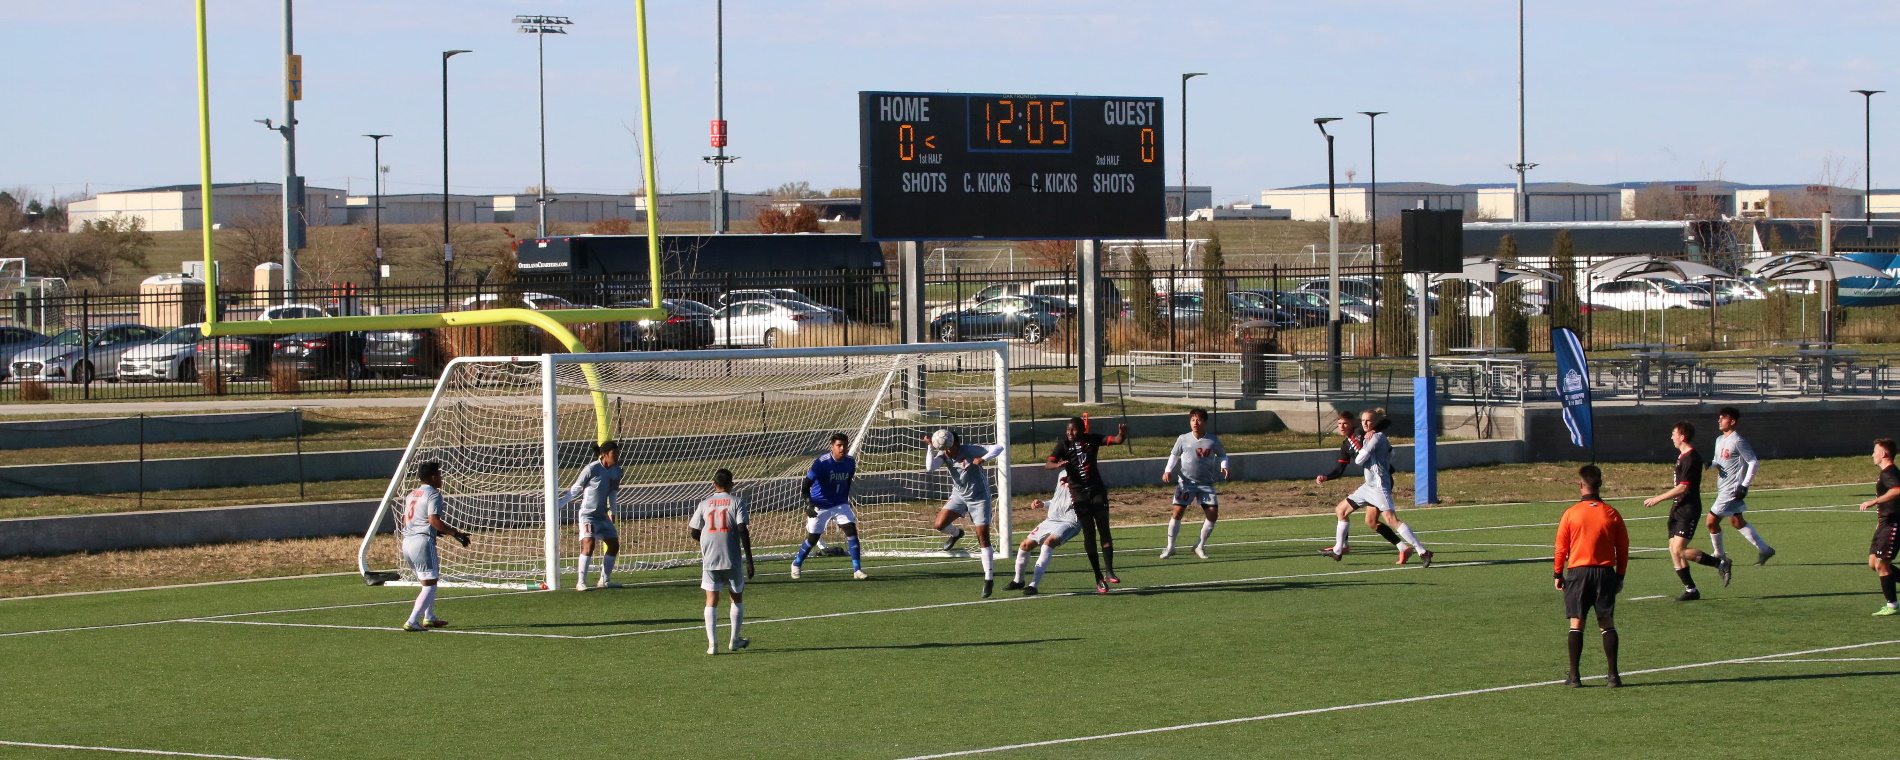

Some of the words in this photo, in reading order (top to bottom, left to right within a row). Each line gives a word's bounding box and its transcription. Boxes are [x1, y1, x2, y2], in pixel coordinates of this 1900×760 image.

[880, 97, 930, 121] HOME
[1104, 101, 1155, 125] GUEST
[986, 101, 1067, 144] 12:05
[899, 124, 914, 161] 0
[1140, 128, 1155, 163] 0
[919, 154, 927, 164] 1st
[928, 154, 943, 164] HALF
[1096, 155, 1106, 166] 2nd
[1107, 155, 1120, 166] HALF
[902, 172, 947, 193] SHOTS
[964, 173, 974, 193] C.
[978, 173, 1011, 193] KICKS
[1032, 173, 1042, 193] C.
[1046, 173, 1078, 193] KICKS
[1093, 173, 1134, 193] SHOTS
[1197, 447, 1210, 457] 20
[830, 473, 849, 483] PIMA
[407, 500, 417, 521] 3
[708, 499, 731, 507] PIMA
[707, 508, 730, 532] 11
